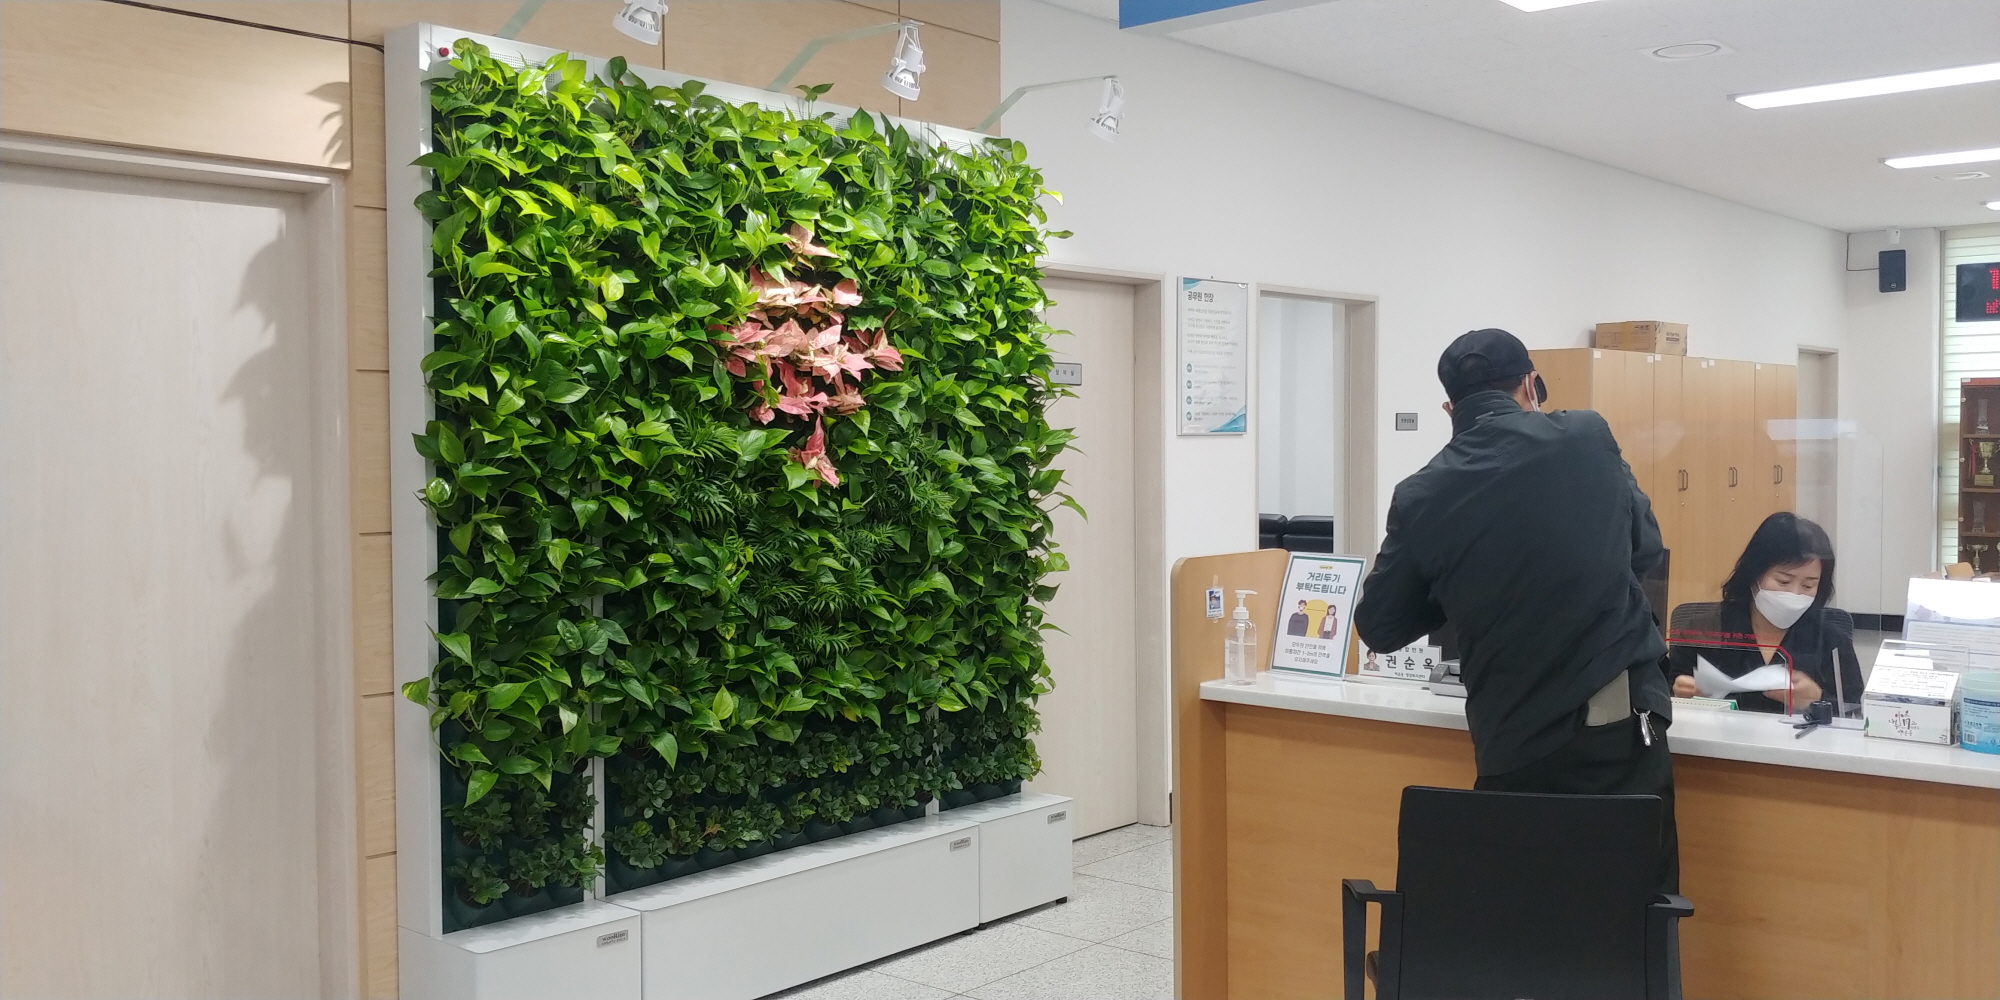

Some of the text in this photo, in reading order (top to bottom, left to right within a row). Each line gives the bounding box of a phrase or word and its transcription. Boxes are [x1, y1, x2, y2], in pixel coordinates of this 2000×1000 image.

[1187, 291, 1214, 303] 공무원 헌장
[1306, 572, 1341, 583] 거리두기
[1296, 582, 1347, 595] 부탁드립니다
